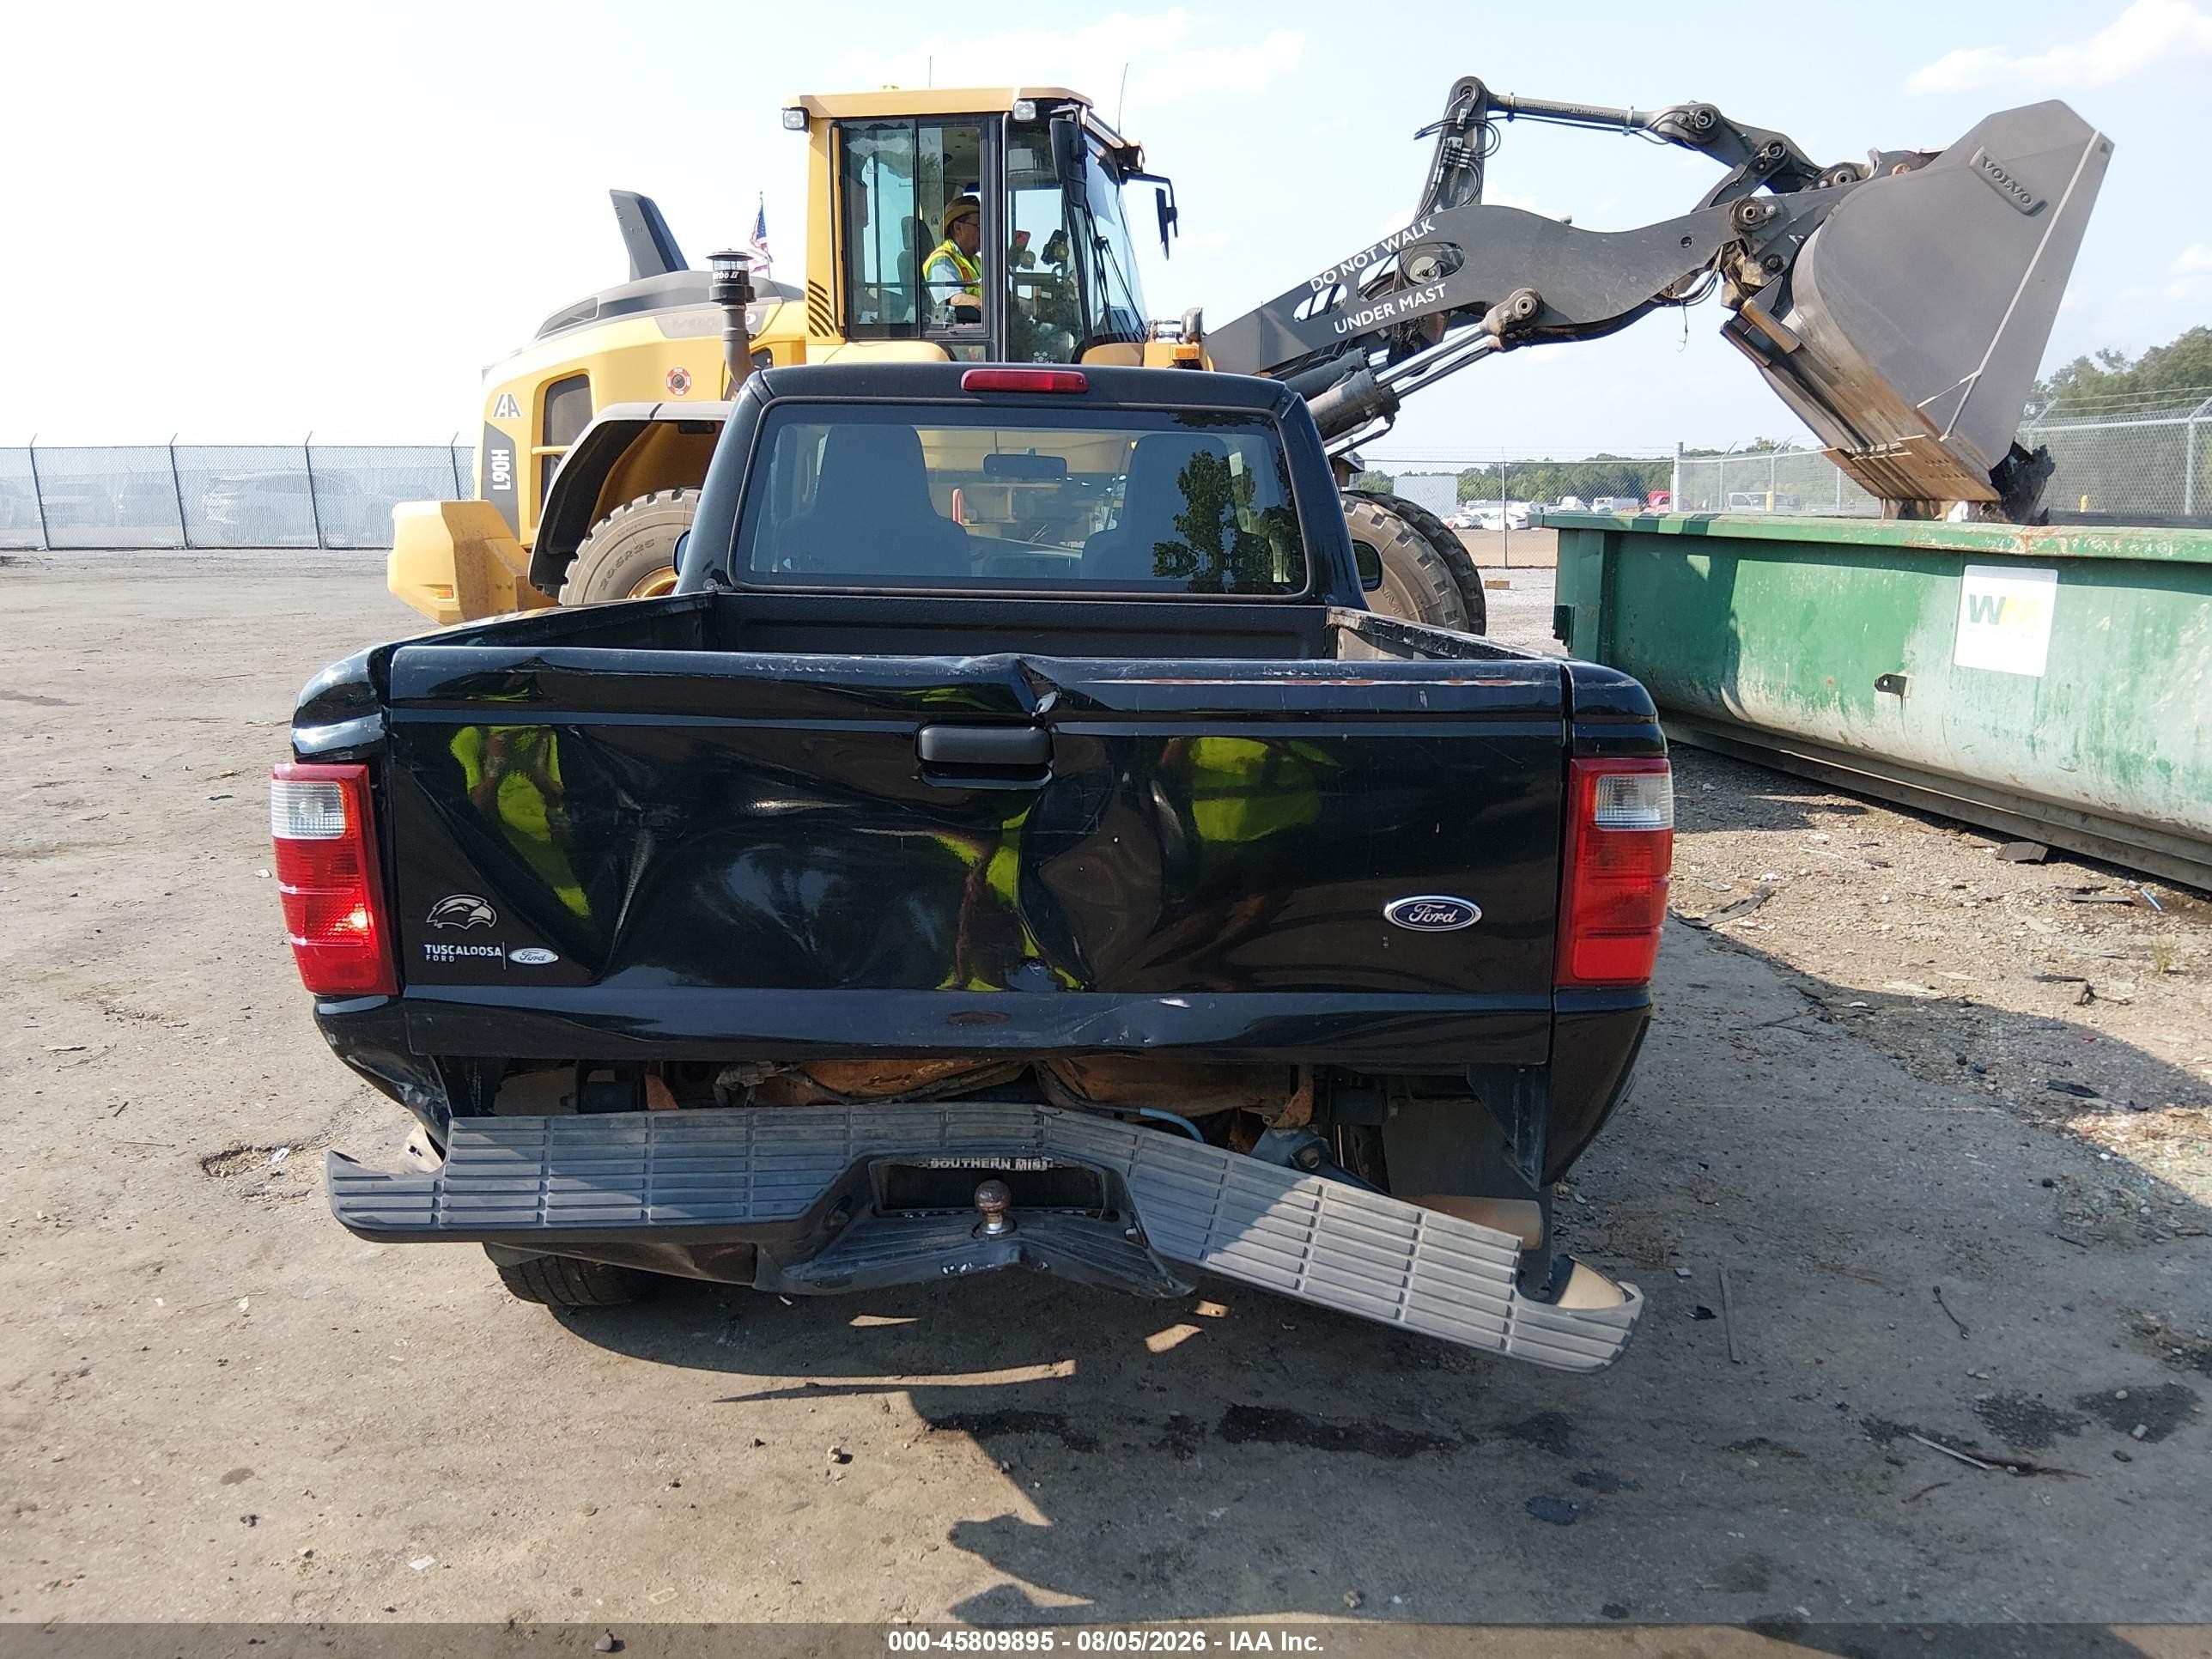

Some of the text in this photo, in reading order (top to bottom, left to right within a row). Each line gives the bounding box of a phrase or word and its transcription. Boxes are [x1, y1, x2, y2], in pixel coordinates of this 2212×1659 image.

[1983, 156, 2033, 206] VOLVO
[1310, 218, 1436, 292] DO NOT WALK
[1334, 283, 1446, 334] UNDER MAST
[491, 449, 512, 490] L90H
[1408, 903, 1458, 923] Ford
[424, 945, 502, 957] TUSCALOOSA
[930, 1158, 1011, 1170] SOUTHERN
